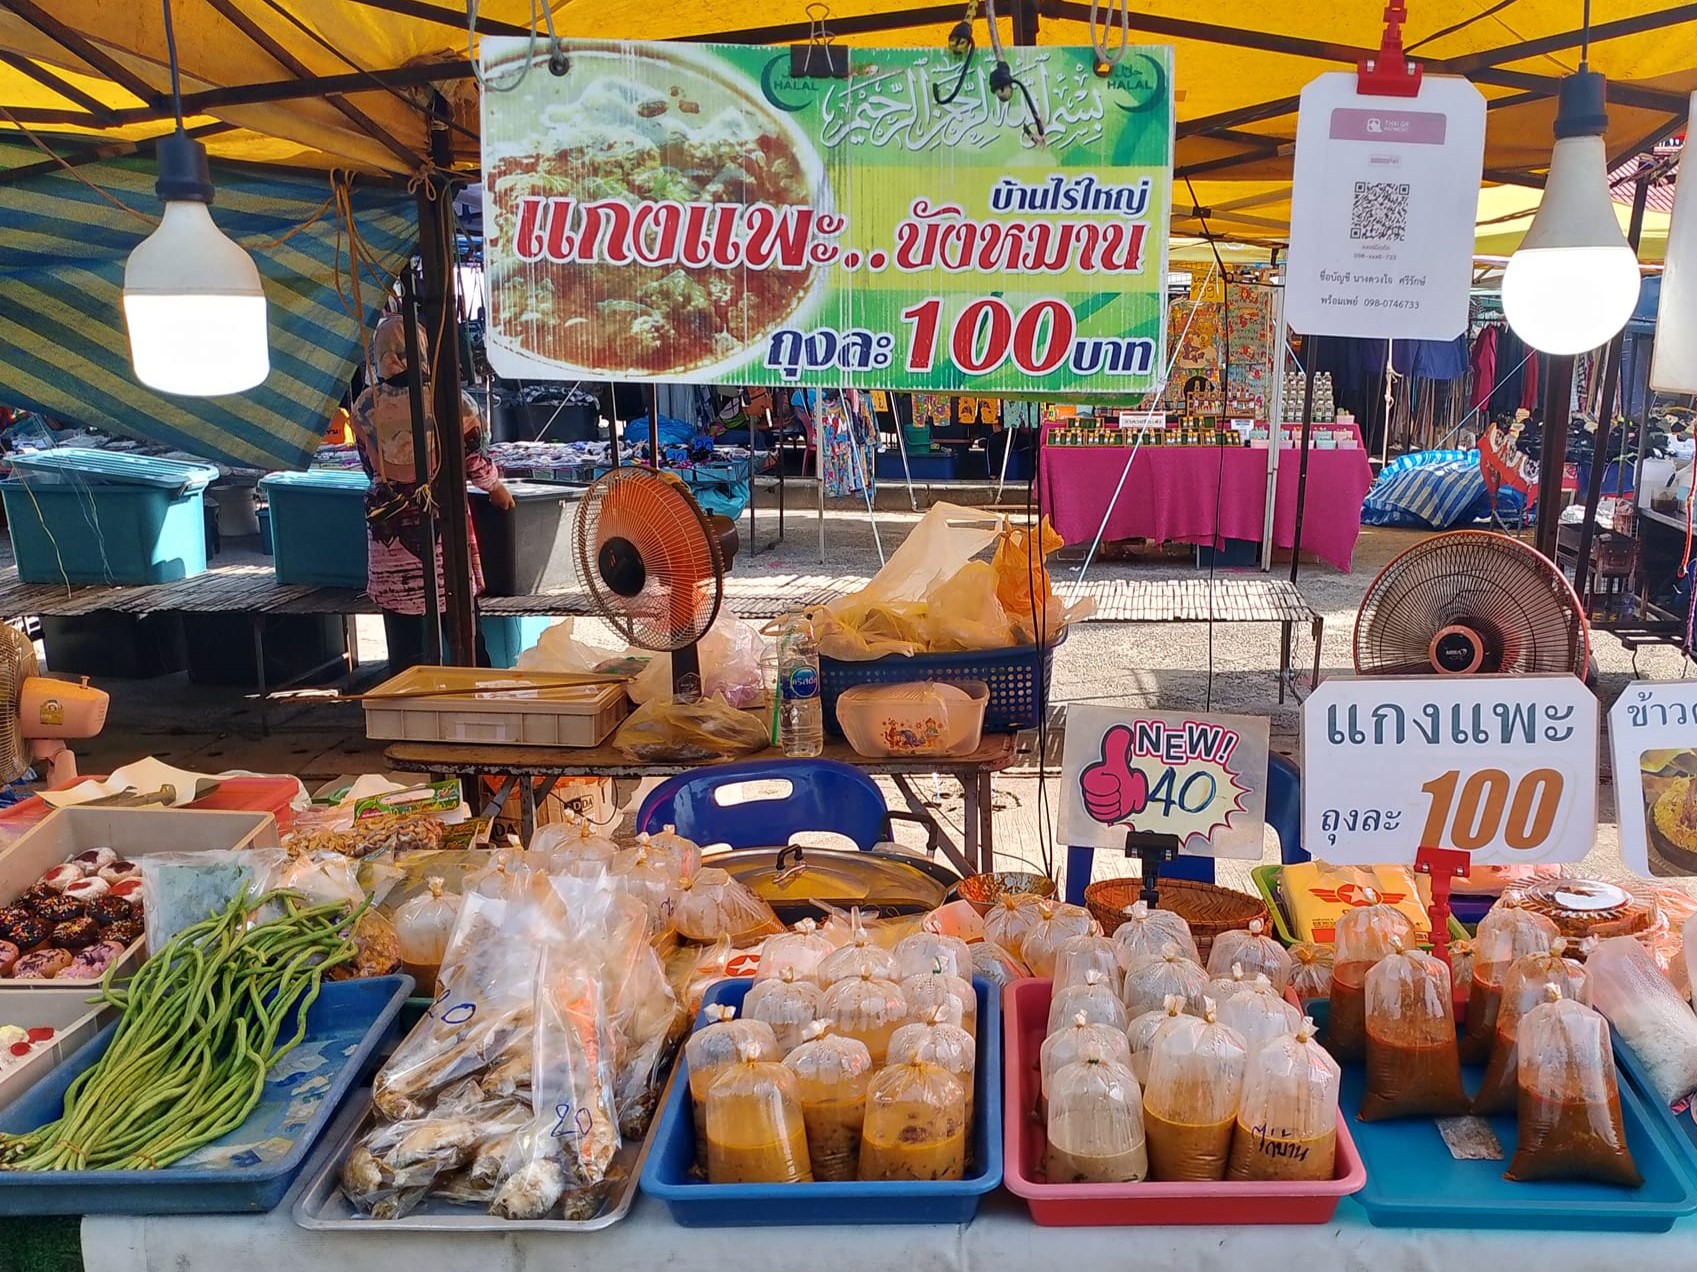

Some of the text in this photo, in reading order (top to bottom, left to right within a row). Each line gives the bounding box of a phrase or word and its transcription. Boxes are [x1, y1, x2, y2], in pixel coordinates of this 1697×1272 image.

[774, 81, 819, 91] HALAL
[1107, 81, 1153, 90] HALAL
[992, 177, 1150, 215] บ้านไร่ใหญ่
[1363, 298, 1420, 310] 098-0746733
[1136, 723, 1236, 762] NEW!
[1327, 702, 1575, 745] แกงแพะ
[1146, 766, 1217, 817] 40
[1321, 767, 1565, 850] ถุงละ 100
[550, 1103, 593, 1138] 20
